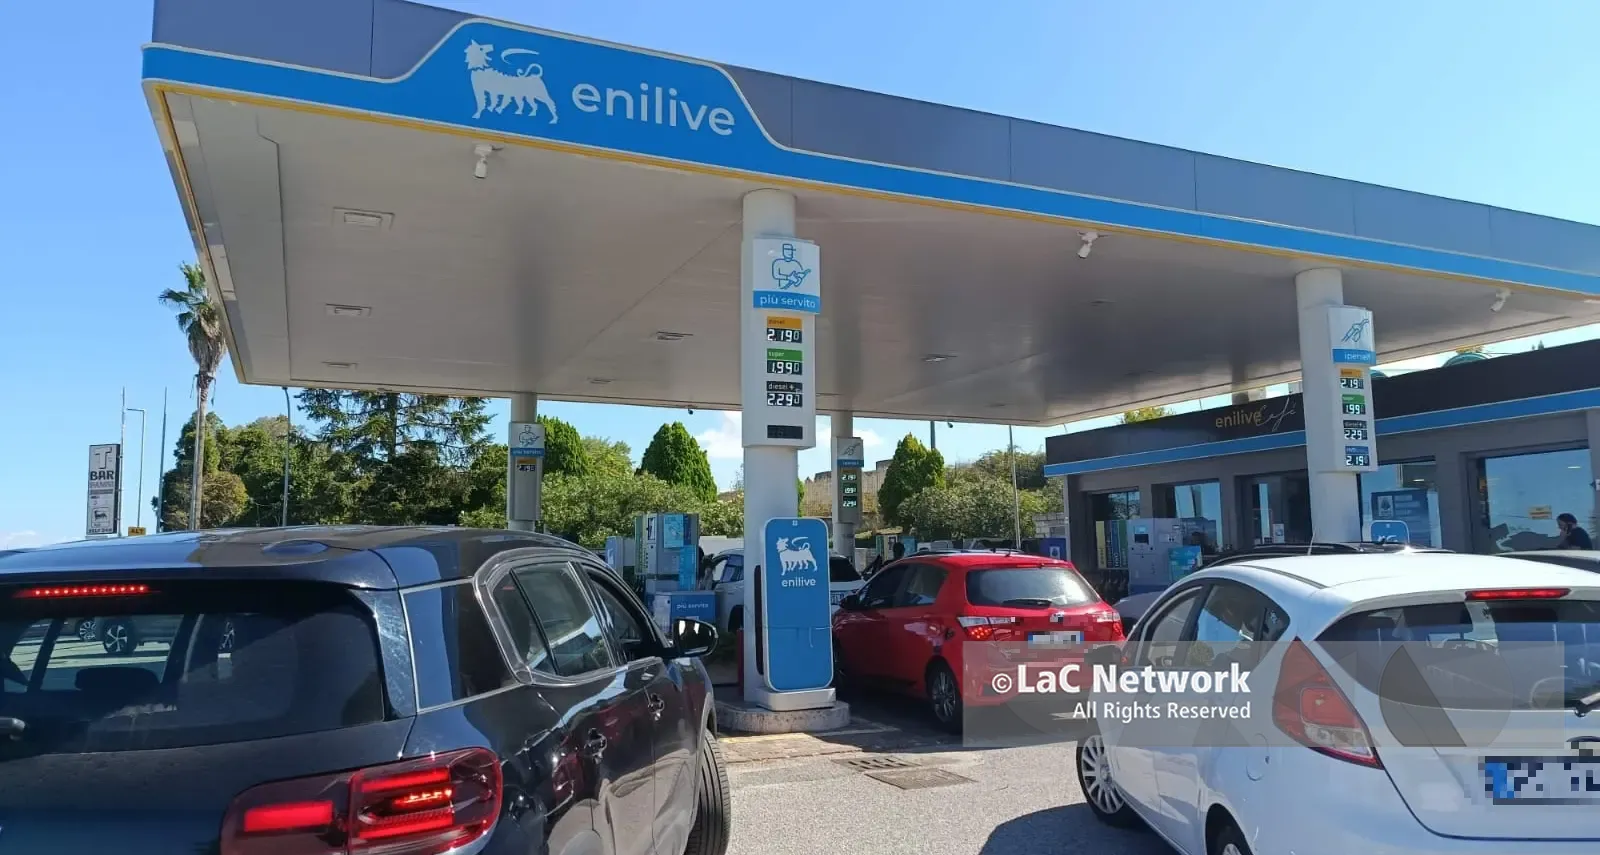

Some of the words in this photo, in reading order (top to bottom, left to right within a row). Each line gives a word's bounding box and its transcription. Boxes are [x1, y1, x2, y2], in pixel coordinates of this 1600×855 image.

[571, 82, 735, 136] enilive
[760, 294, 778, 306] più
[781, 296, 816, 308] servito
[767, 328, 800, 342] 2.190
[768, 382, 788, 390] diesel
[767, 393, 800, 405] 2.290
[1215, 408, 1262, 428] enilive
[90, 470, 114, 480] BAR
[781, 577, 817, 587] enilive
